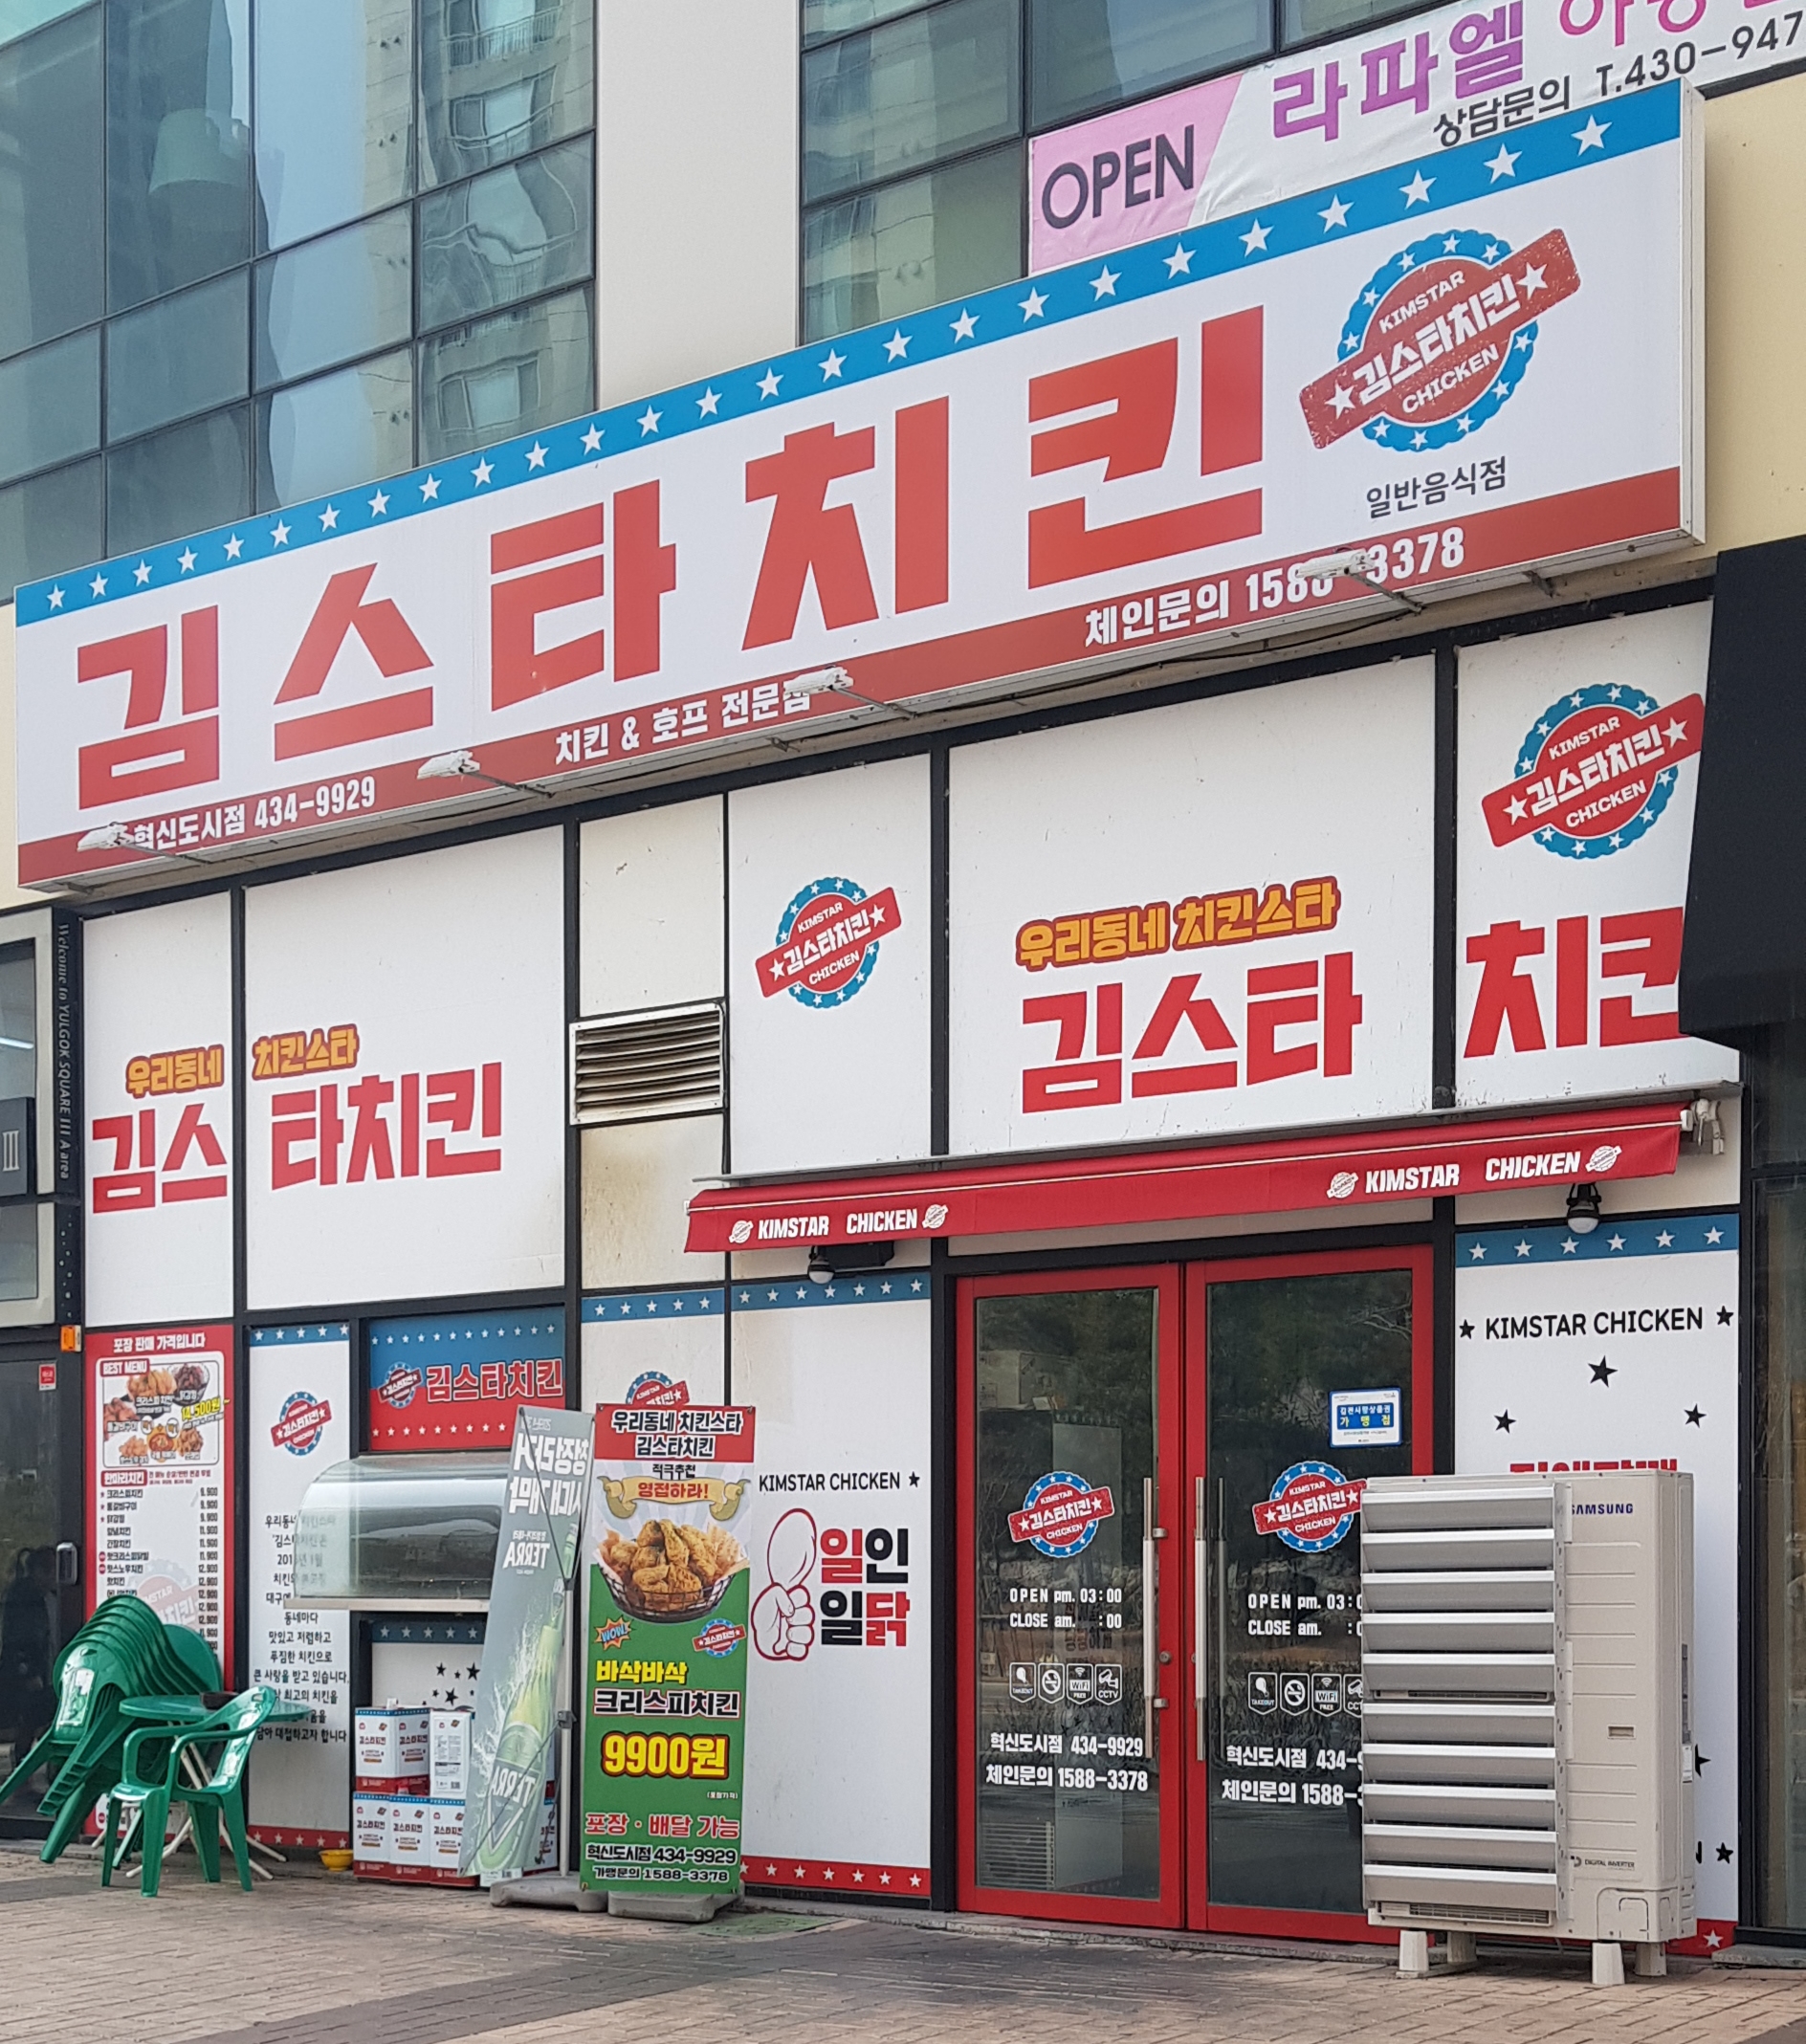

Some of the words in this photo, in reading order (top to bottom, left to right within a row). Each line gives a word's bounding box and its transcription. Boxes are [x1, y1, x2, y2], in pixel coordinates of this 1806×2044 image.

[1274, 1, 1523, 142] 라파엘
[1434, 76, 1570, 146] 상담문의
[1042, 124, 1194, 229] OPEN
[1379, 271, 1465, 333] KIMSTAR
[1354, 274, 1520, 406] 김스타치킨
[1402, 343, 1499, 413] CHICKEN
[1367, 457, 1506, 518] 일반음식점
[77, 305, 1264, 809] 김스타치킨
[1086, 580, 1229, 647] 체인문의
[556, 723, 608, 765] 치킨
[622, 717, 639, 750] &
[652, 699, 708, 743] 호프
[1549, 715, 1620, 761] KIMSTAR
[1526, 724, 1664, 818] 김스타치킨
[254, 776, 375, 828] 434-9929
[1566, 780, 1646, 827] CHICKEN
[798, 902, 843, 934] KIMSTAR
[1016, 901, 1170, 972] 우리동네
[1173, 875, 1341, 951] 치킨스타
[58, 923, 69, 983] Welcome
[783, 909, 871, 976] 김스타치킨
[809, 950, 859, 984] CHICKEN
[58, 1004, 70, 1058] YULGOK
[1023, 952, 1362, 1113] 김스타
[127, 1045, 223, 1097] 우리동네
[253, 1025, 359, 1079] 치킨스타
[58, 1061, 71, 1114] SQUARE
[59, 1139, 71, 1150] A
[93, 1103, 227, 1214] 김스
[272, 1062, 501, 1191] 타치킨
[1365, 1164, 1459, 1193] KIMSTAR
[1486, 1152, 1581, 1181] CHICKEN
[758, 1216, 828, 1240] KIMSTAR
[847, 1209, 917, 1234] CHICKEN
[1486, 1313, 1586, 1340] KIMSTAR
[1594, 1307, 1703, 1334] CHICKEN
[157, 1332, 206, 1350] 가격입니다
[124, 1360, 146, 1374] MENU
[426, 1358, 562, 1402] 김스타치킨
[613, 1411, 675, 1433] 우리동네
[680, 1411, 742, 1434] 치킨스타
[636, 1436, 716, 1459] 김스타치킨
[638, 1483, 709, 1499] 영접하라!
[759, 1473, 825, 1491] KIMSTAR
[829, 1472, 900, 1490] CHICKEN
[1288, 1481, 1327, 1496] KIMSTAR
[1029, 1497, 1092, 1530] 김스타치킨
[1276, 1491, 1347, 1523] 김스타치킨
[1046, 1524, 1083, 1539] CHICKEN
[1294, 1516, 1335, 1533] CHICKEN
[821, 1528, 908, 1583] 일인
[1009, 1588, 1048, 1603] OPEN
[1054, 1591, 1076, 1604] pm.
[1247, 1593, 1291, 1610] OPEN
[1297, 1596, 1321, 1611] pm.
[284, 1612, 319, 1625] 동네마다
[601, 1622, 628, 1642] WOW!
[820, 1591, 910, 1646] 일닭
[1009, 1613, 1048, 1628] CLOSE
[1054, 1615, 1076, 1628] am.
[1247, 1619, 1291, 1636] CLOSE
[1297, 1623, 1322, 1637] am.
[269, 1632, 295, 1644] 맛있고
[297, 1631, 332, 1644] 저렴하고
[270, 1651, 296, 1663] 푸짐한
[298, 1651, 333, 1663] 치킨으로
[596, 1659, 688, 1684] 바삭바삭
[265, 1669, 289, 1682] 사랑을
[292, 1670, 309, 1682] 받고
[1071, 1681, 1090, 1690] WiFi
[284, 1690, 310, 1703] 최고의
[313, 1689, 338, 1704] 치킨을
[594, 1690, 739, 1717] 크리스피치킨
[1098, 1690, 1118, 1699] CCTV
[1317, 1691, 1336, 1702] WiFi
[275, 1727, 319, 1742] 대접하고자
[320, 1728, 347, 1743] 합니다
[990, 1732, 1063, 1754] 혁신도시점
[1070, 1735, 1143, 1757] 434-9929
[603, 1733, 727, 1778] 9900원
[1226, 1745, 1307, 1768] 혁신도시점
[985, 1764, 1053, 1787] 체인문의
[1057, 1768, 1149, 1791] 1588-3378
[1222, 1778, 1296, 1804] 체인문의
[585, 1813, 628, 1835] 포장
[650, 1815, 692, 1837] 배달
[696, 1817, 739, 1838] 가능
[586, 1844, 651, 1862] 혁신도시점
[653, 1846, 736, 1864] 434-9929
[643, 1867, 729, 1881] 1588-3378
